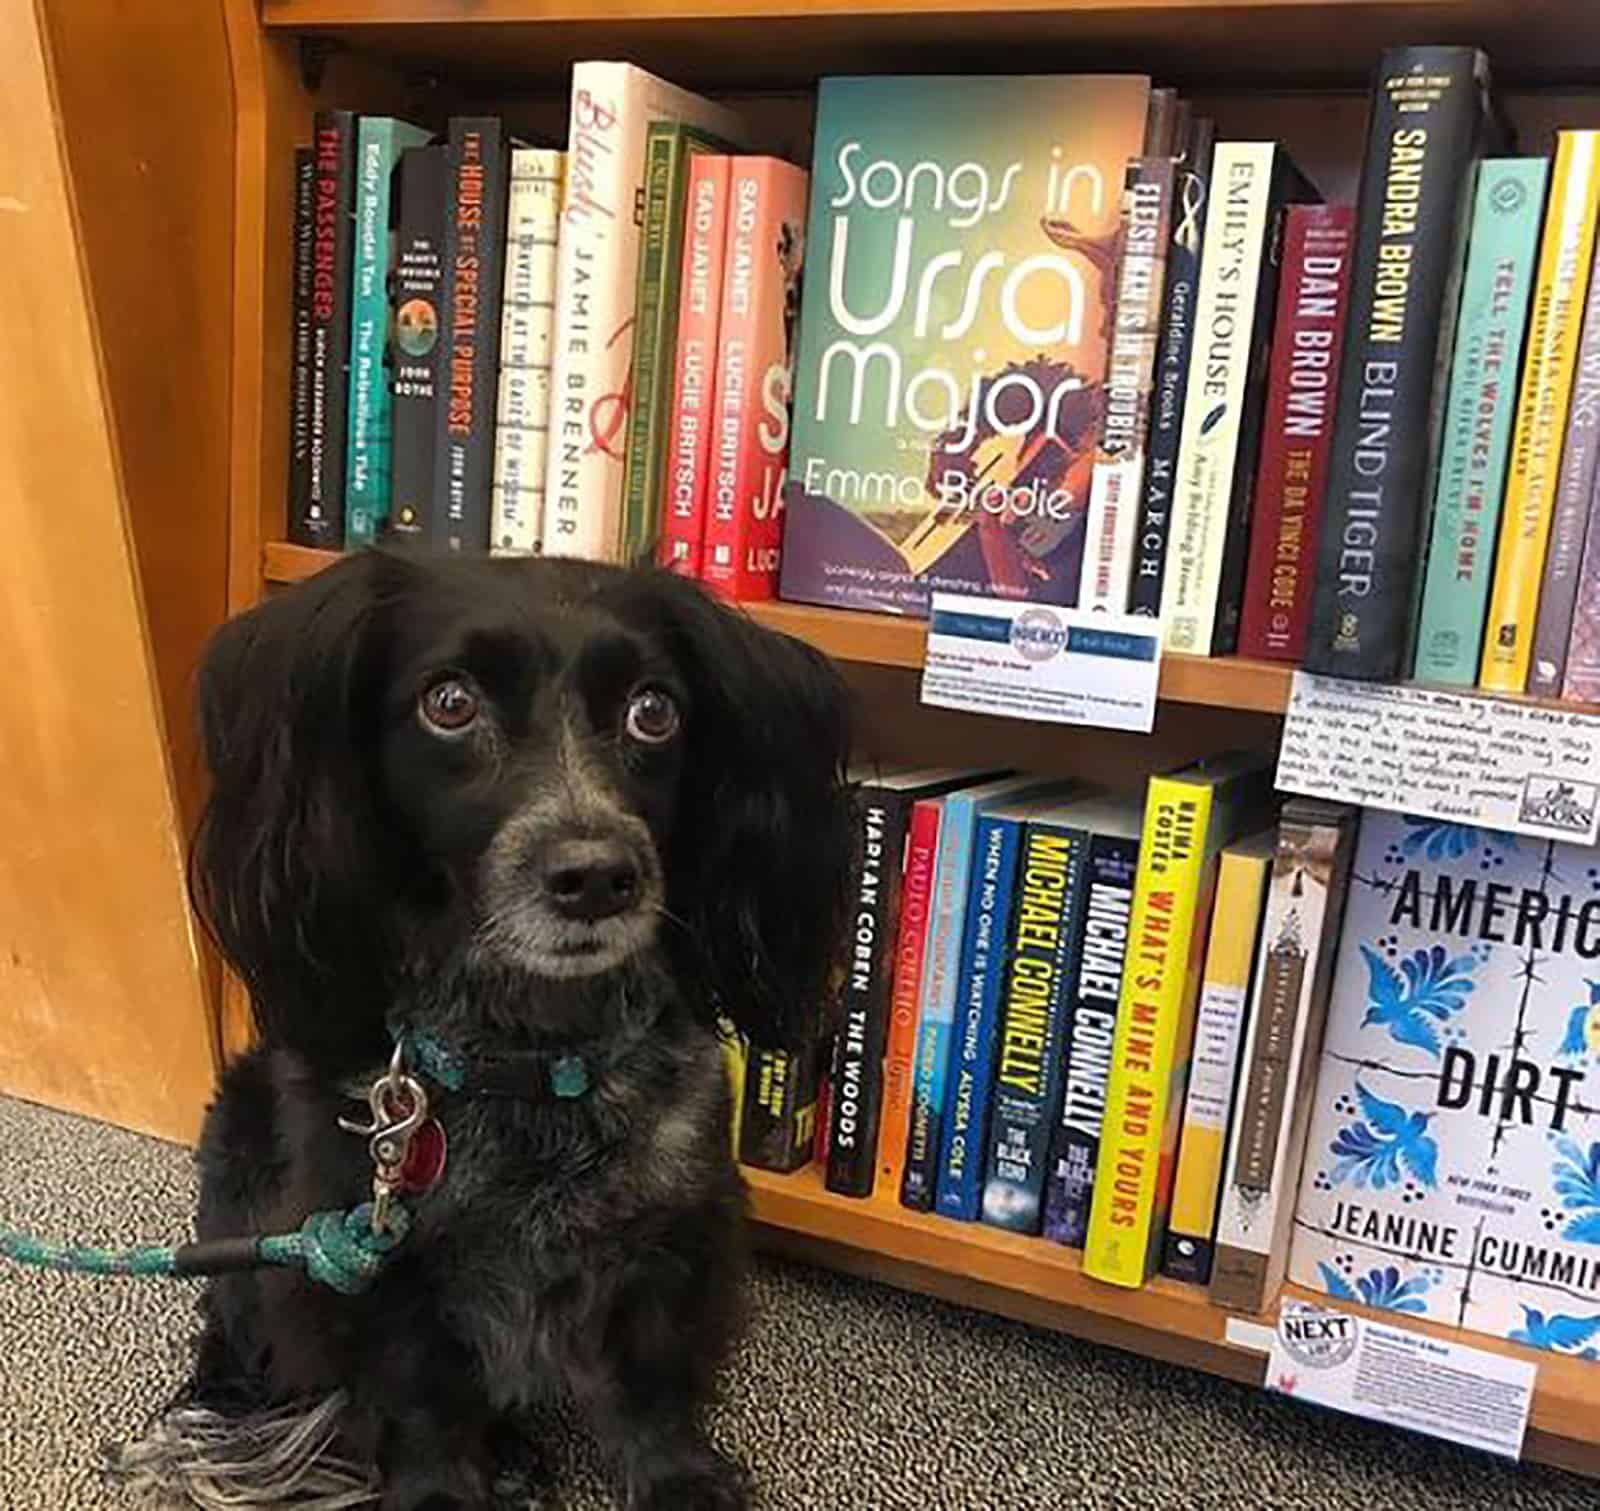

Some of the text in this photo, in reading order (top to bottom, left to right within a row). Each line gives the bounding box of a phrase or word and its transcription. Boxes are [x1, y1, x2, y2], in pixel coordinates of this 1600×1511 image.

[364, 143, 380, 190] Eddy
[456, 165, 485, 231] HOUSE
[831, 142, 1102, 228] Songs in
[1382, 129, 1428, 237] SANDRA
[313, 130, 338, 318] THE PASSENGER
[690, 179, 715, 314] SAD JANET
[730, 180, 758, 314] SAD JANET
[1121, 183, 1161, 301] FLEISHMAN
[361, 266, 376, 297] Tan
[452, 256, 479, 339] SPECIAL
[829, 215, 1085, 346] Ursa
[1120, 310, 1146, 327] IS
[1203, 161, 1255, 397] EMILY'S HOUSE
[1297, 256, 1342, 317] DAN
[1369, 244, 1414, 342] BROWN
[1491, 260, 1515, 318] TELL
[360, 320, 373, 351] The
[1159, 281, 1191, 430] Geraldine Brooks
[1283, 330, 1334, 435] BROWN
[1484, 329, 1505, 373] THE
[447, 345, 476, 437] PURPOSE
[558, 248, 593, 535] JAMIE BRENNER
[675, 340, 704, 517] LUCIE BRITSCH
[715, 339, 744, 520] LUCIE BRITSCH
[815, 340, 1084, 453] Major
[1102, 361, 1140, 456] TROUBLE
[1353, 361, 1398, 476] BLIND
[1472, 381, 1499, 470] WOLVES
[804, 457, 1074, 520] Emma Brodie
[1283, 485, 1308, 508] DA
[1286, 449, 1312, 480] THE
[1141, 458, 1171, 577] MARCH
[1337, 484, 1383, 597] TIGER
[1456, 521, 1482, 581] HOME
[904, 846, 930, 920] PAULO
[1151, 805, 1175, 874] COSTER
[1172, 802, 1197, 859] NAIMA
[852, 808, 886, 991] HARLAN COBEN
[962, 827, 1004, 1061] WHEN NO ONE IS WATCHING
[1016, 834, 1072, 951] MICHAEL
[1079, 882, 1133, 1000] MICHAEL
[1000, 958, 1053, 1093] CONNELLY
[1062, 1007, 1116, 1138] CONNELLY
[1110, 892, 1175, 1228] WHAT'S MINE AND YOURS
[838, 1011, 867, 1149] THE WOODS
[949, 1070, 975, 1179] ALYSSA COLE
[1436, 1045, 1585, 1131] DIRT
[1331, 1202, 1457, 1258] JEANINE
[1284, 1317, 1349, 1340] NEXT
